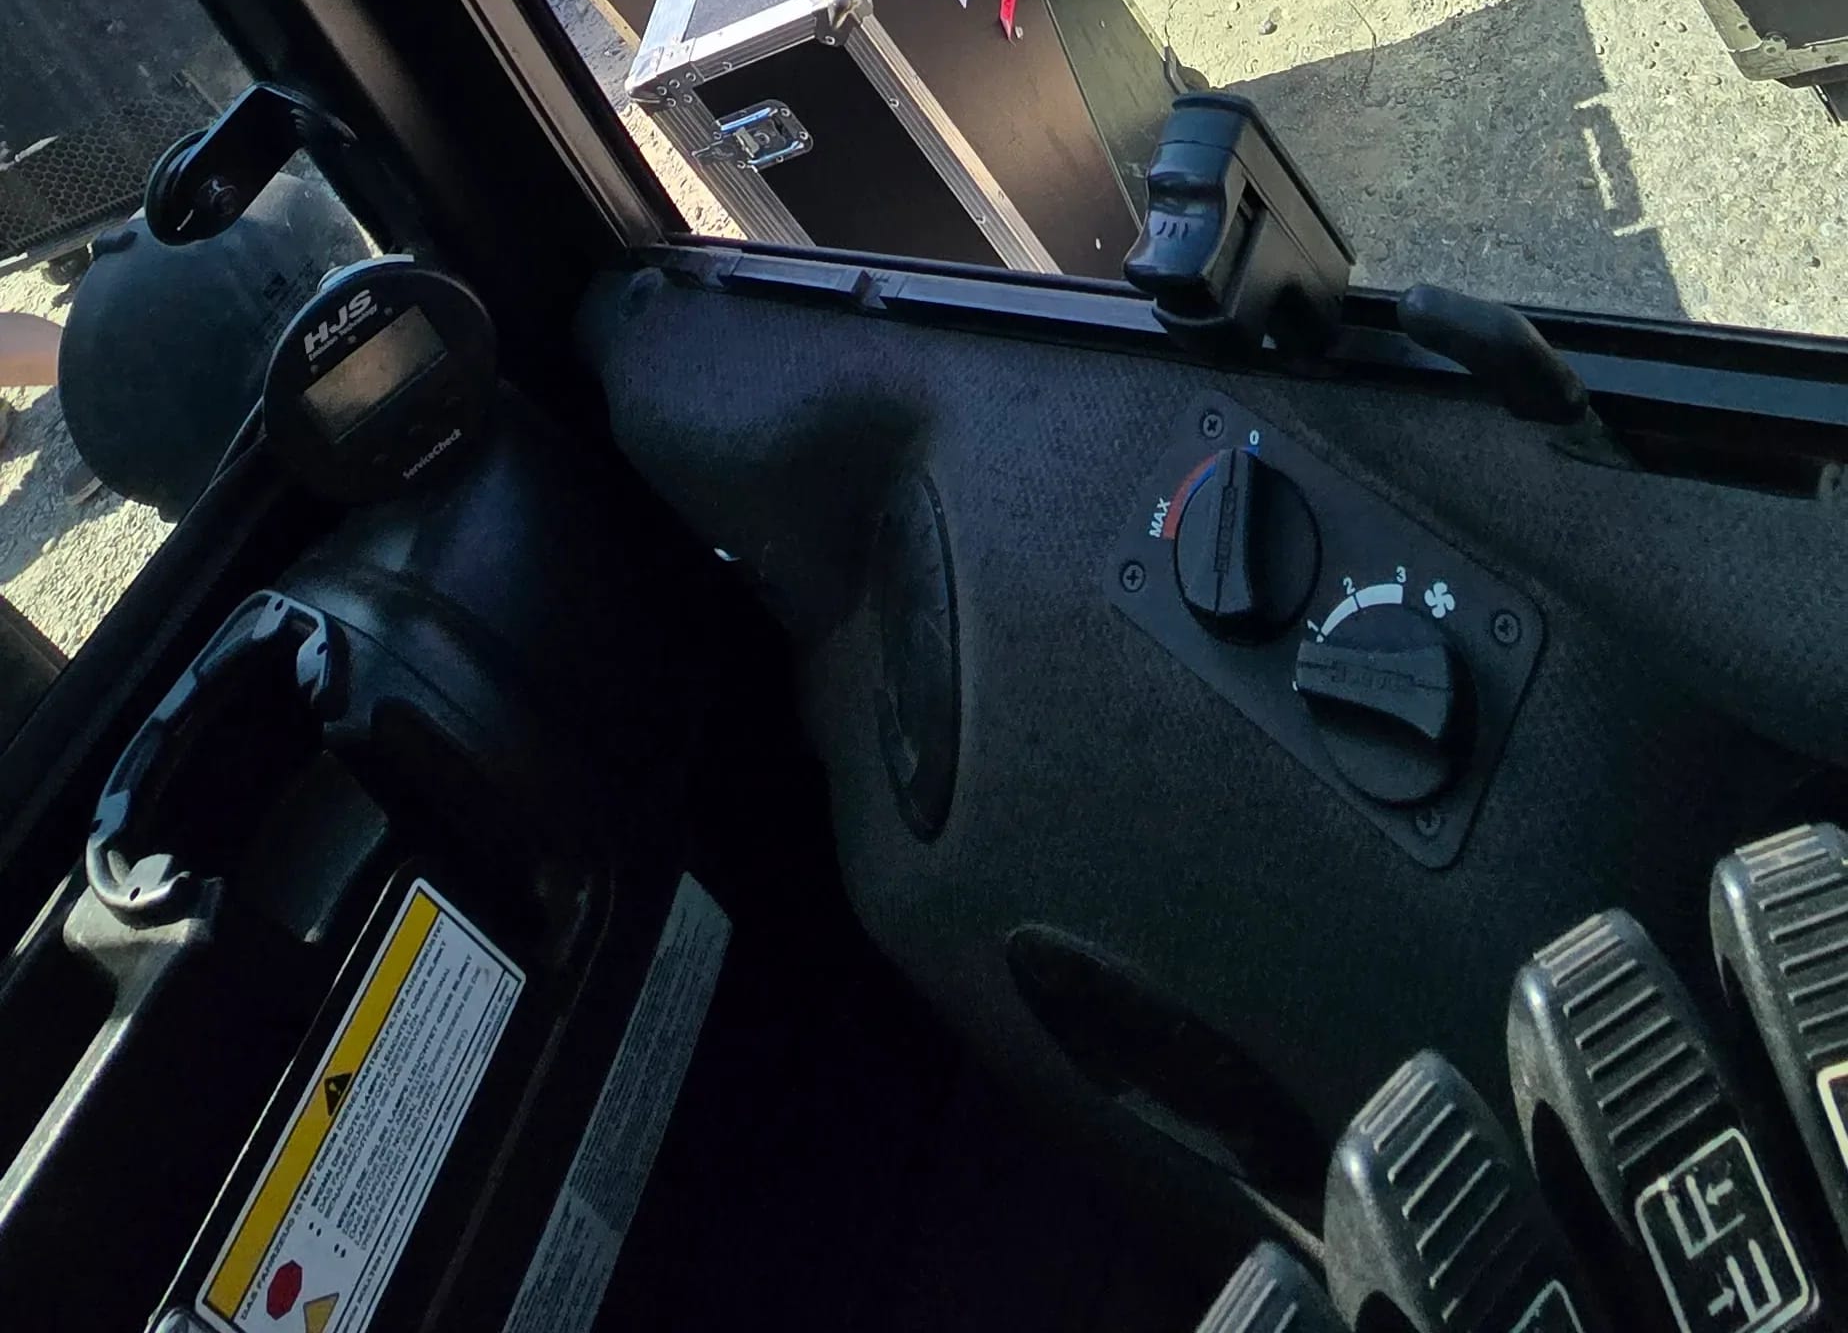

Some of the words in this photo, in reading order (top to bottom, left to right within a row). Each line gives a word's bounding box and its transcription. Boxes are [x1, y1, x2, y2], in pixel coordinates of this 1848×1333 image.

[303, 289, 372, 355] HJS
[1249, 429, 1260, 446] 0
[402, 428, 463, 480] ServiceCheck
[1149, 498, 1173, 538] MAX
[1396, 566, 1408, 583] 3
[1342, 577, 1356, 596] 2
[1307, 619, 1320, 632] 1
